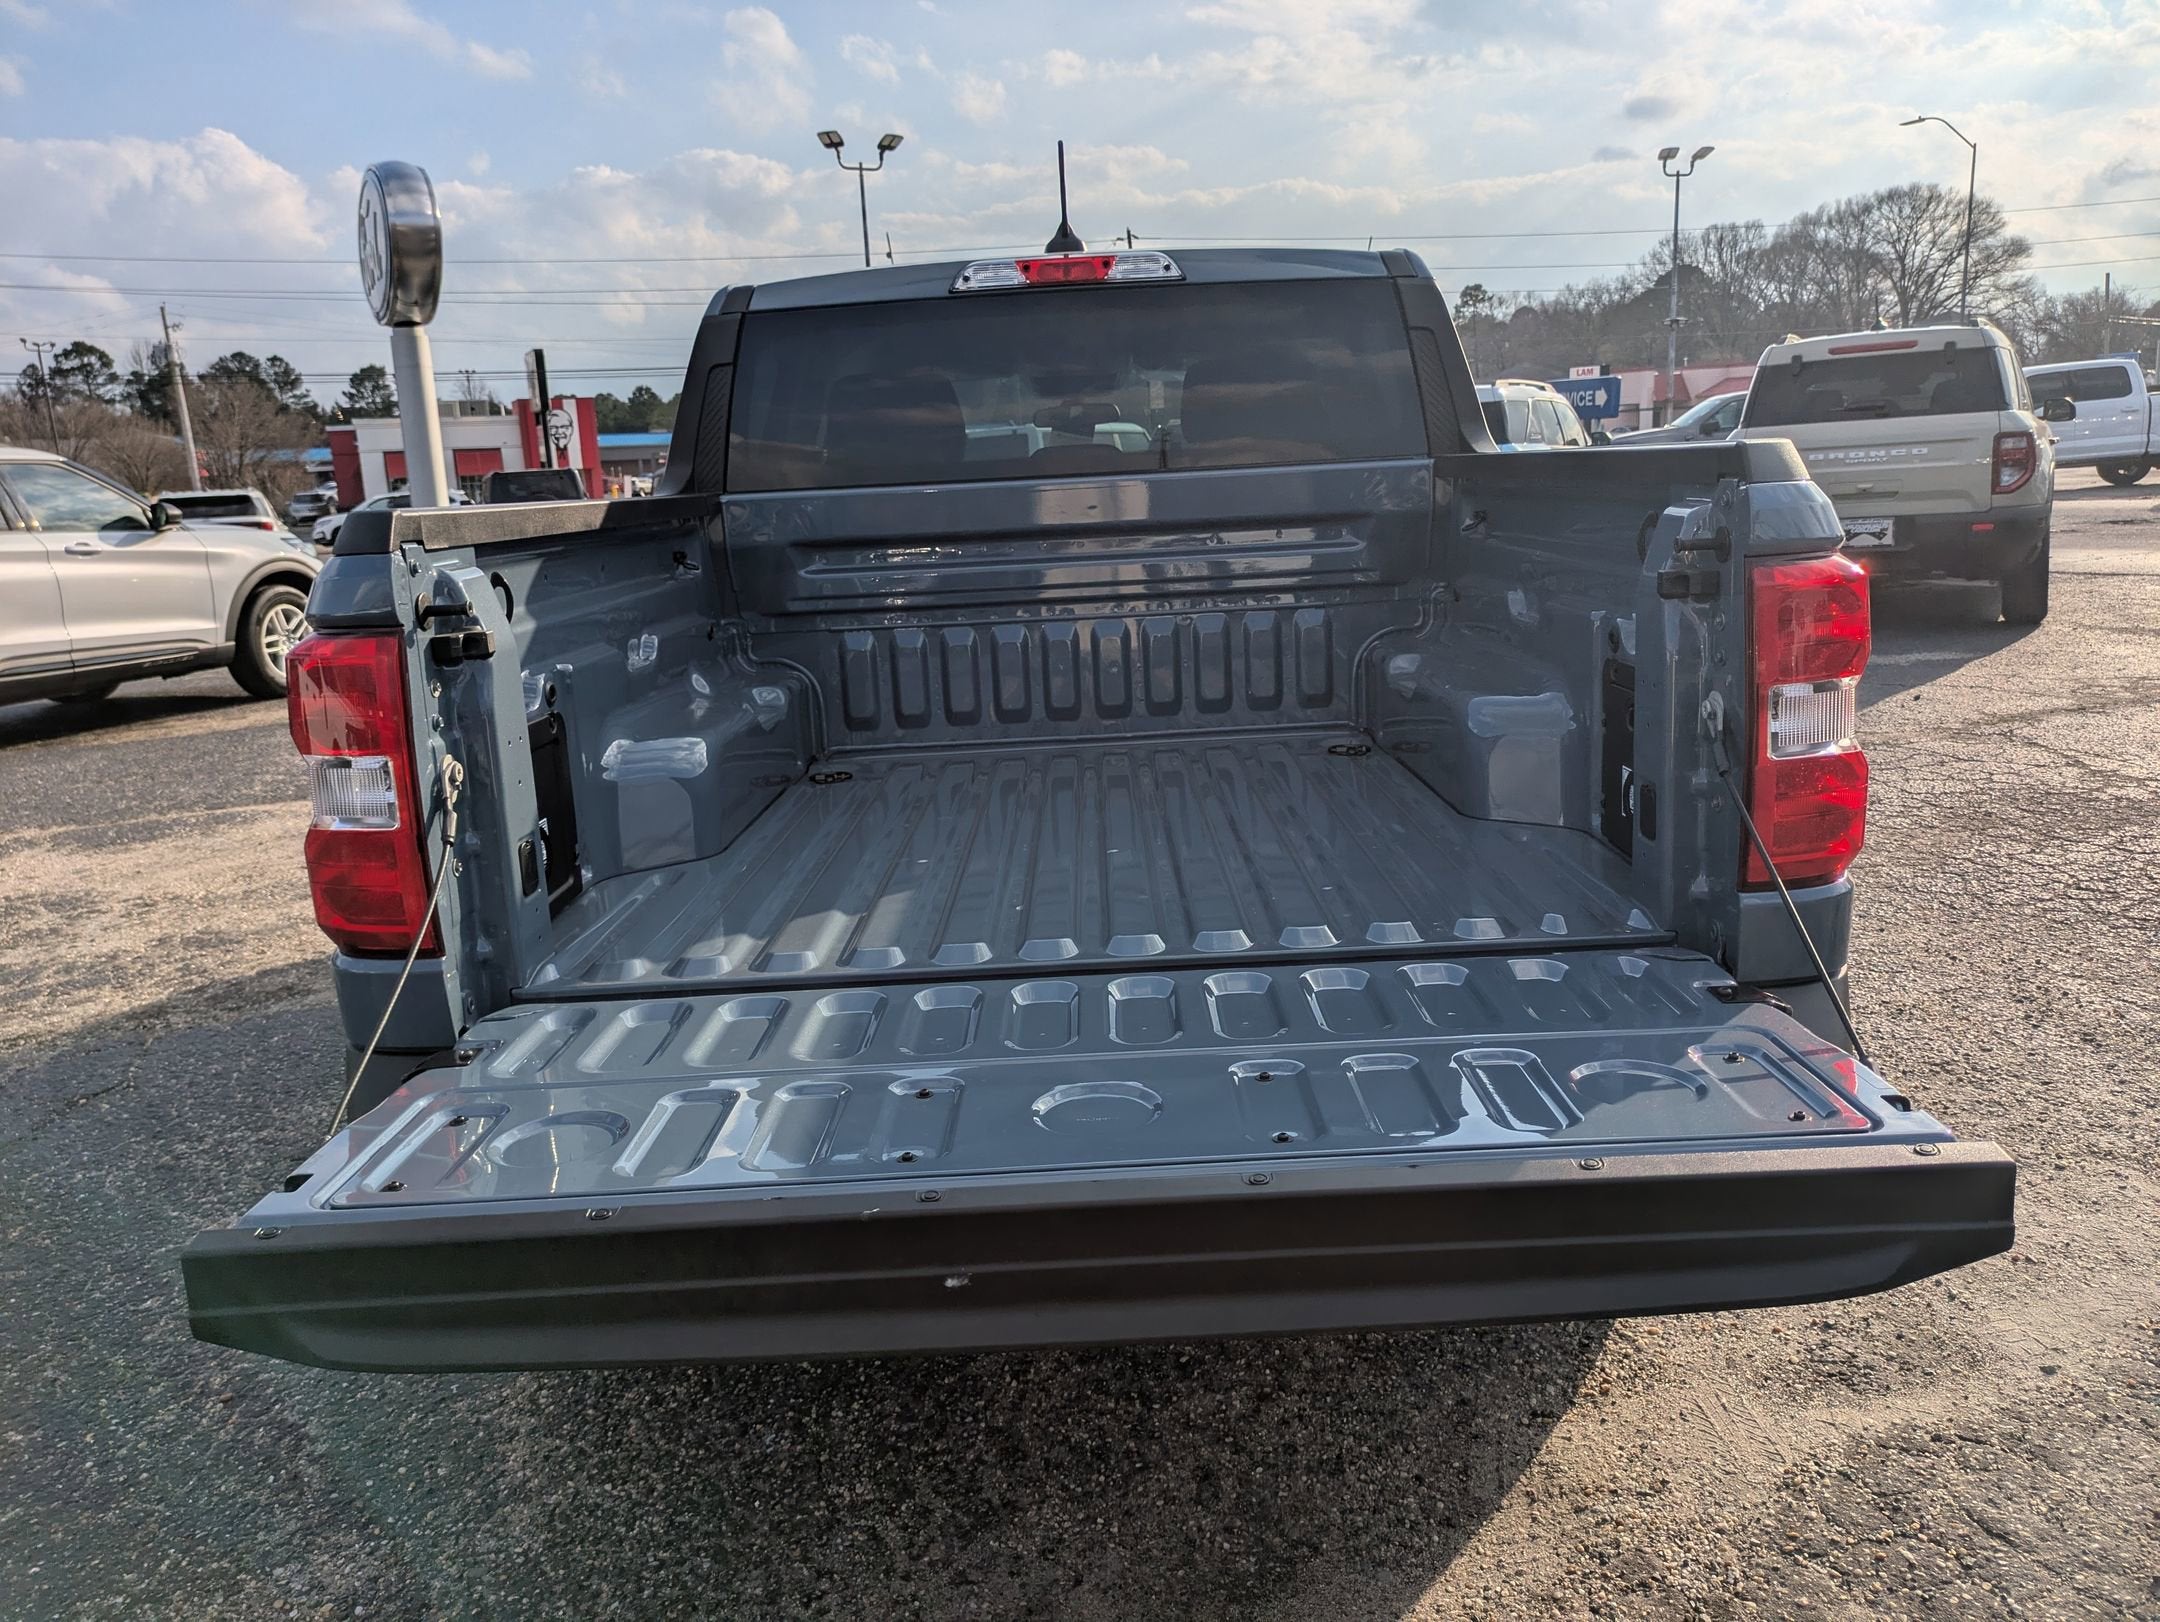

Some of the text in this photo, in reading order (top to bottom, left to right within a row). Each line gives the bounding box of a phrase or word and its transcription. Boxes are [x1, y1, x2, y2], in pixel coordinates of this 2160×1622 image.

[1576, 368, 1594, 377] LAM
[1566, 390, 1594, 407] VICE
[1808, 447, 1929, 461] BRONCO
